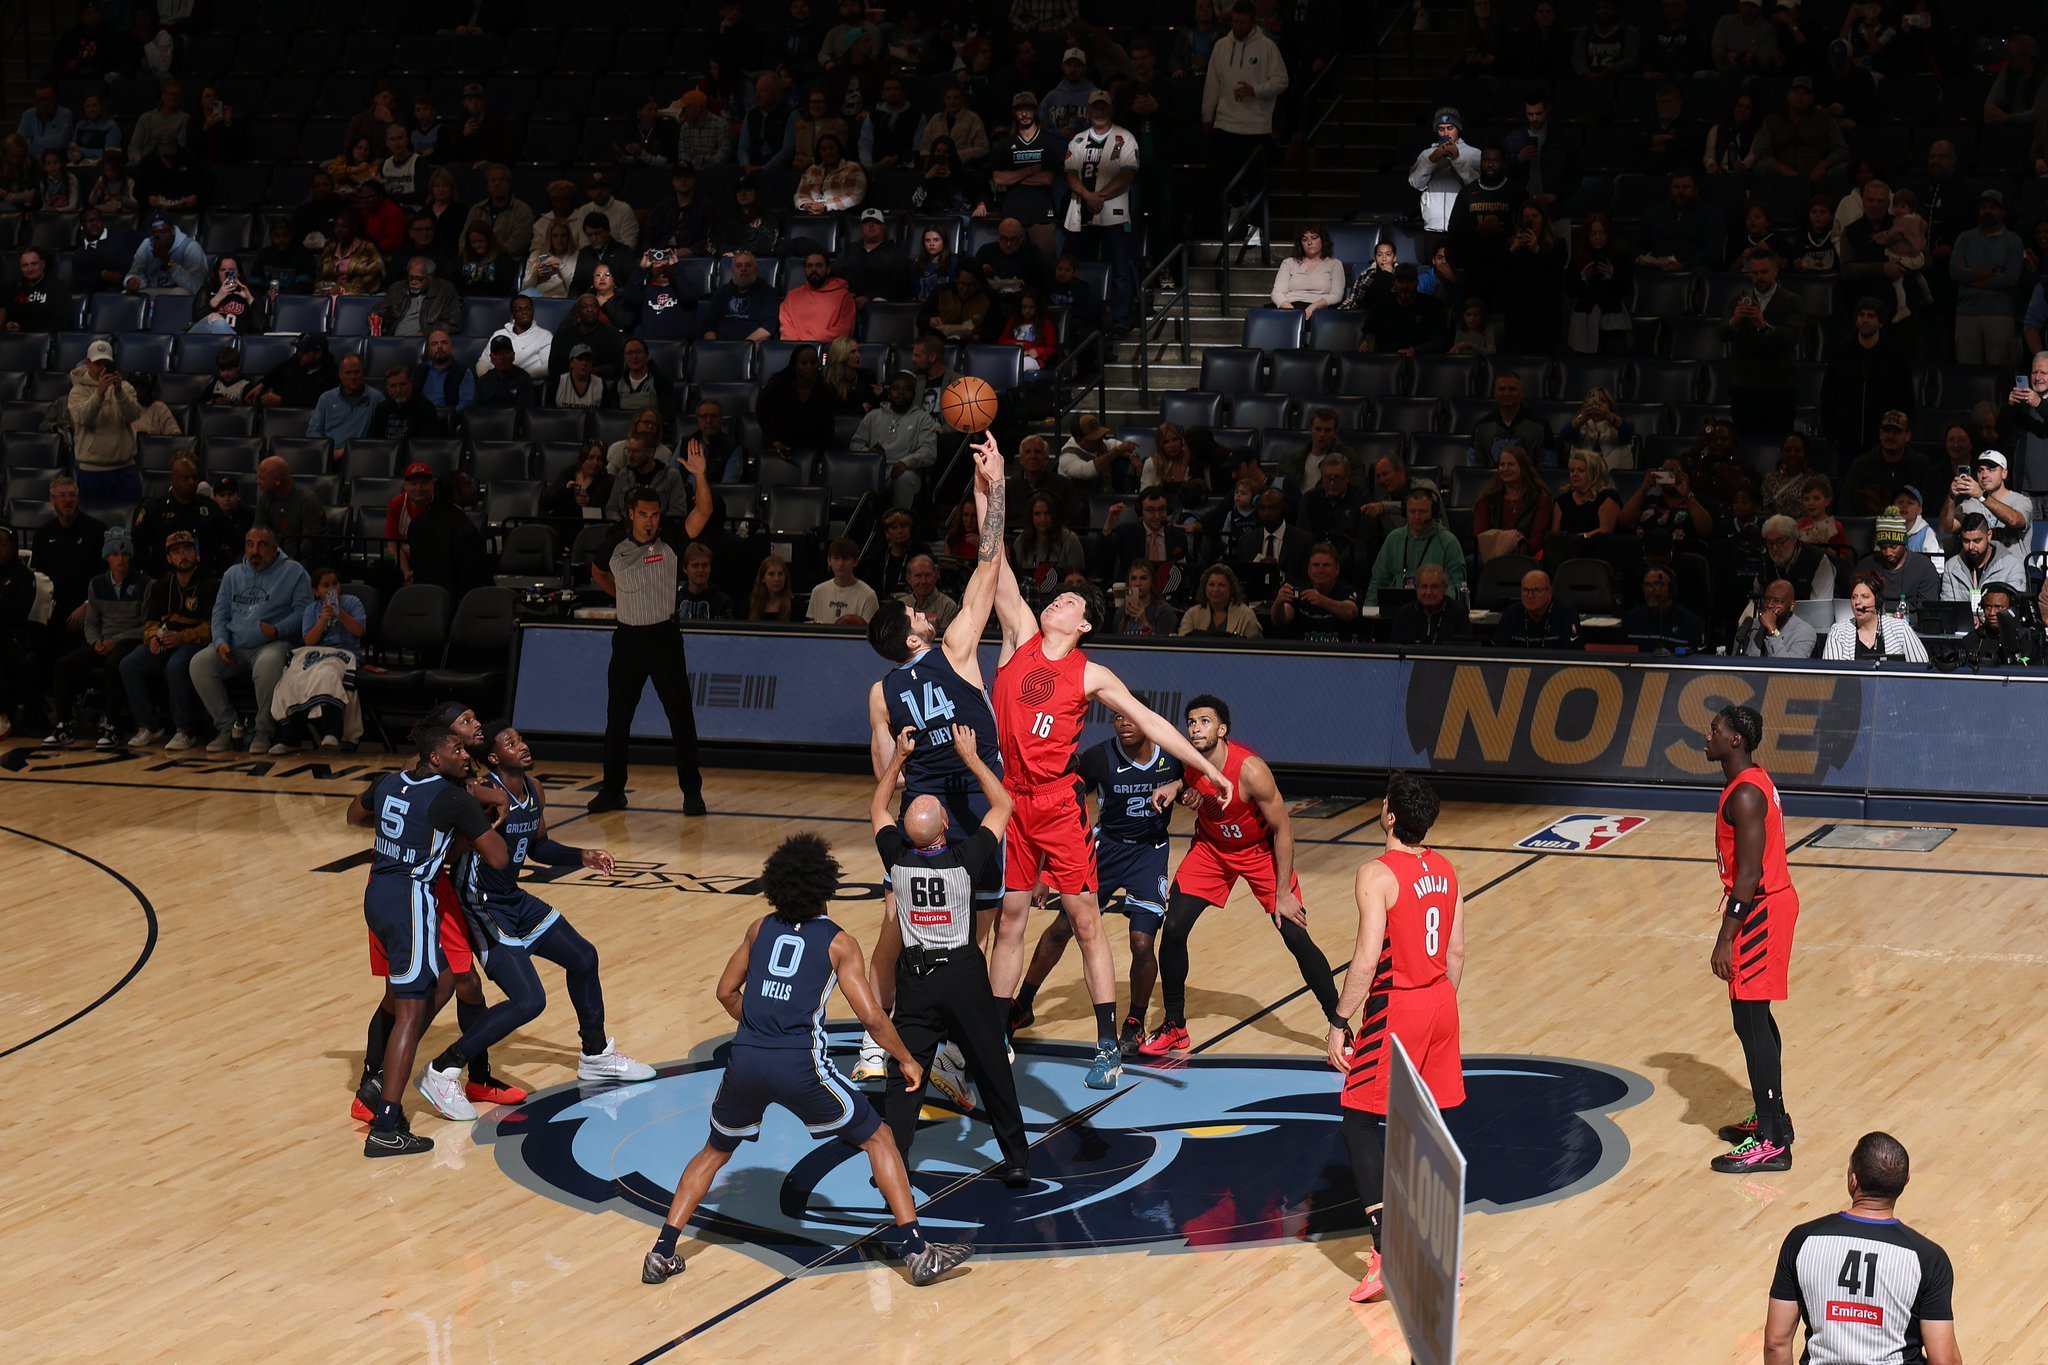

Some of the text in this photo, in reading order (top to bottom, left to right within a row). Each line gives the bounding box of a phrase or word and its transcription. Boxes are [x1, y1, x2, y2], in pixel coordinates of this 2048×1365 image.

[1877, 531, 1905, 542] EEN BAY
[900, 681, 956, 731] 14
[1433, 665, 1838, 775] NOISE
[928, 726, 953, 747] EDEY
[1031, 711, 1055, 740] 16
[380, 794, 411, 840] 5
[1220, 824, 1243, 839] 33
[1528, 839, 1571, 849] NBA
[375, 836, 416, 864] ILLIAMS JR
[512, 837, 529, 863] 8
[910, 876, 947, 907] 68
[1413, 874, 1448, 900] AVDIJA
[913, 913, 948, 922] Emirates
[1425, 906, 1440, 957] 8
[768, 934, 806, 978] 0
[761, 979, 793, 1001] WELLS
[1408, 1128, 1456, 1279] LOUD
[1837, 1249, 1879, 1298] 41
[1831, 1305, 1878, 1321] Emirates
